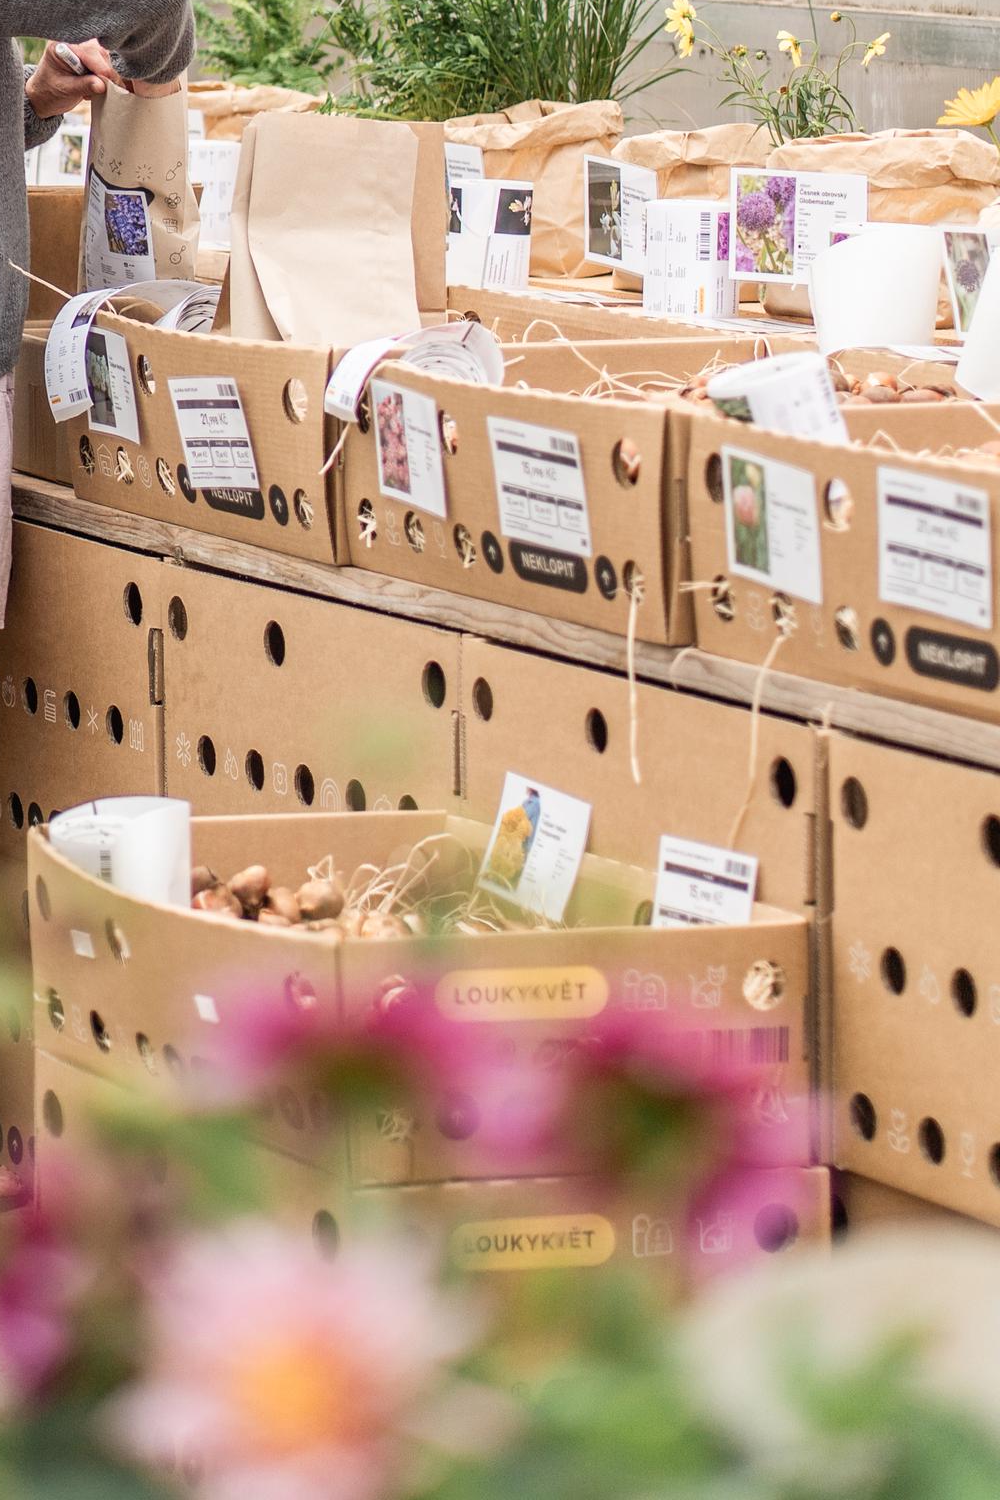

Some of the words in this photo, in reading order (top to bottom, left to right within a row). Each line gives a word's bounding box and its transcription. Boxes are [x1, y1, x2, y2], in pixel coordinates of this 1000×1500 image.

[799, 188, 820, 197] Česnek
[821, 190, 847, 199] obrovský
[799, 197, 835, 206] Globemaster
[211, 488, 253, 507] NEKLOPIT
[520, 552, 575, 578] NEKLOPIT
[454, 980, 587, 1004] LOUKYKVĚT
